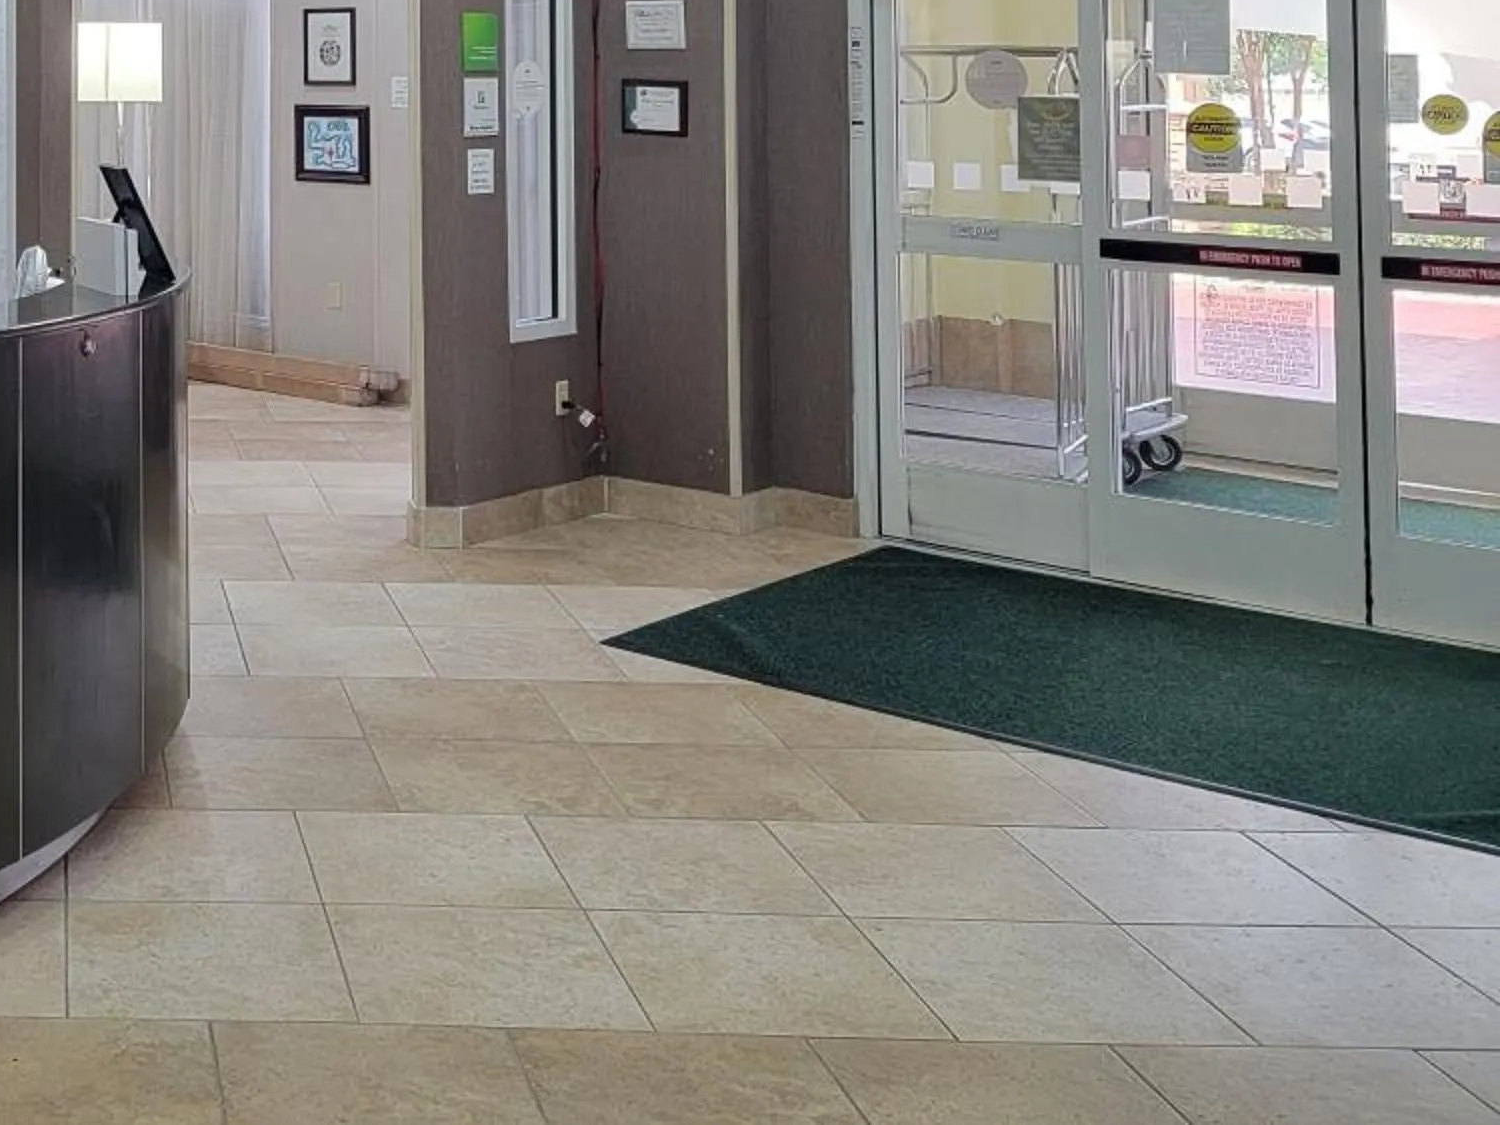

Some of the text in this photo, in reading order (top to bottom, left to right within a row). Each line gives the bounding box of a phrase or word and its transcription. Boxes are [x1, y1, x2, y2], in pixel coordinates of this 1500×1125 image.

[1209, 251, 1250, 263] EMERGENCY
[1251, 255, 1271, 265] PUSH
[1282, 257, 1302, 268] OPEN
[1431, 266, 1478, 279] EMERGENCY
